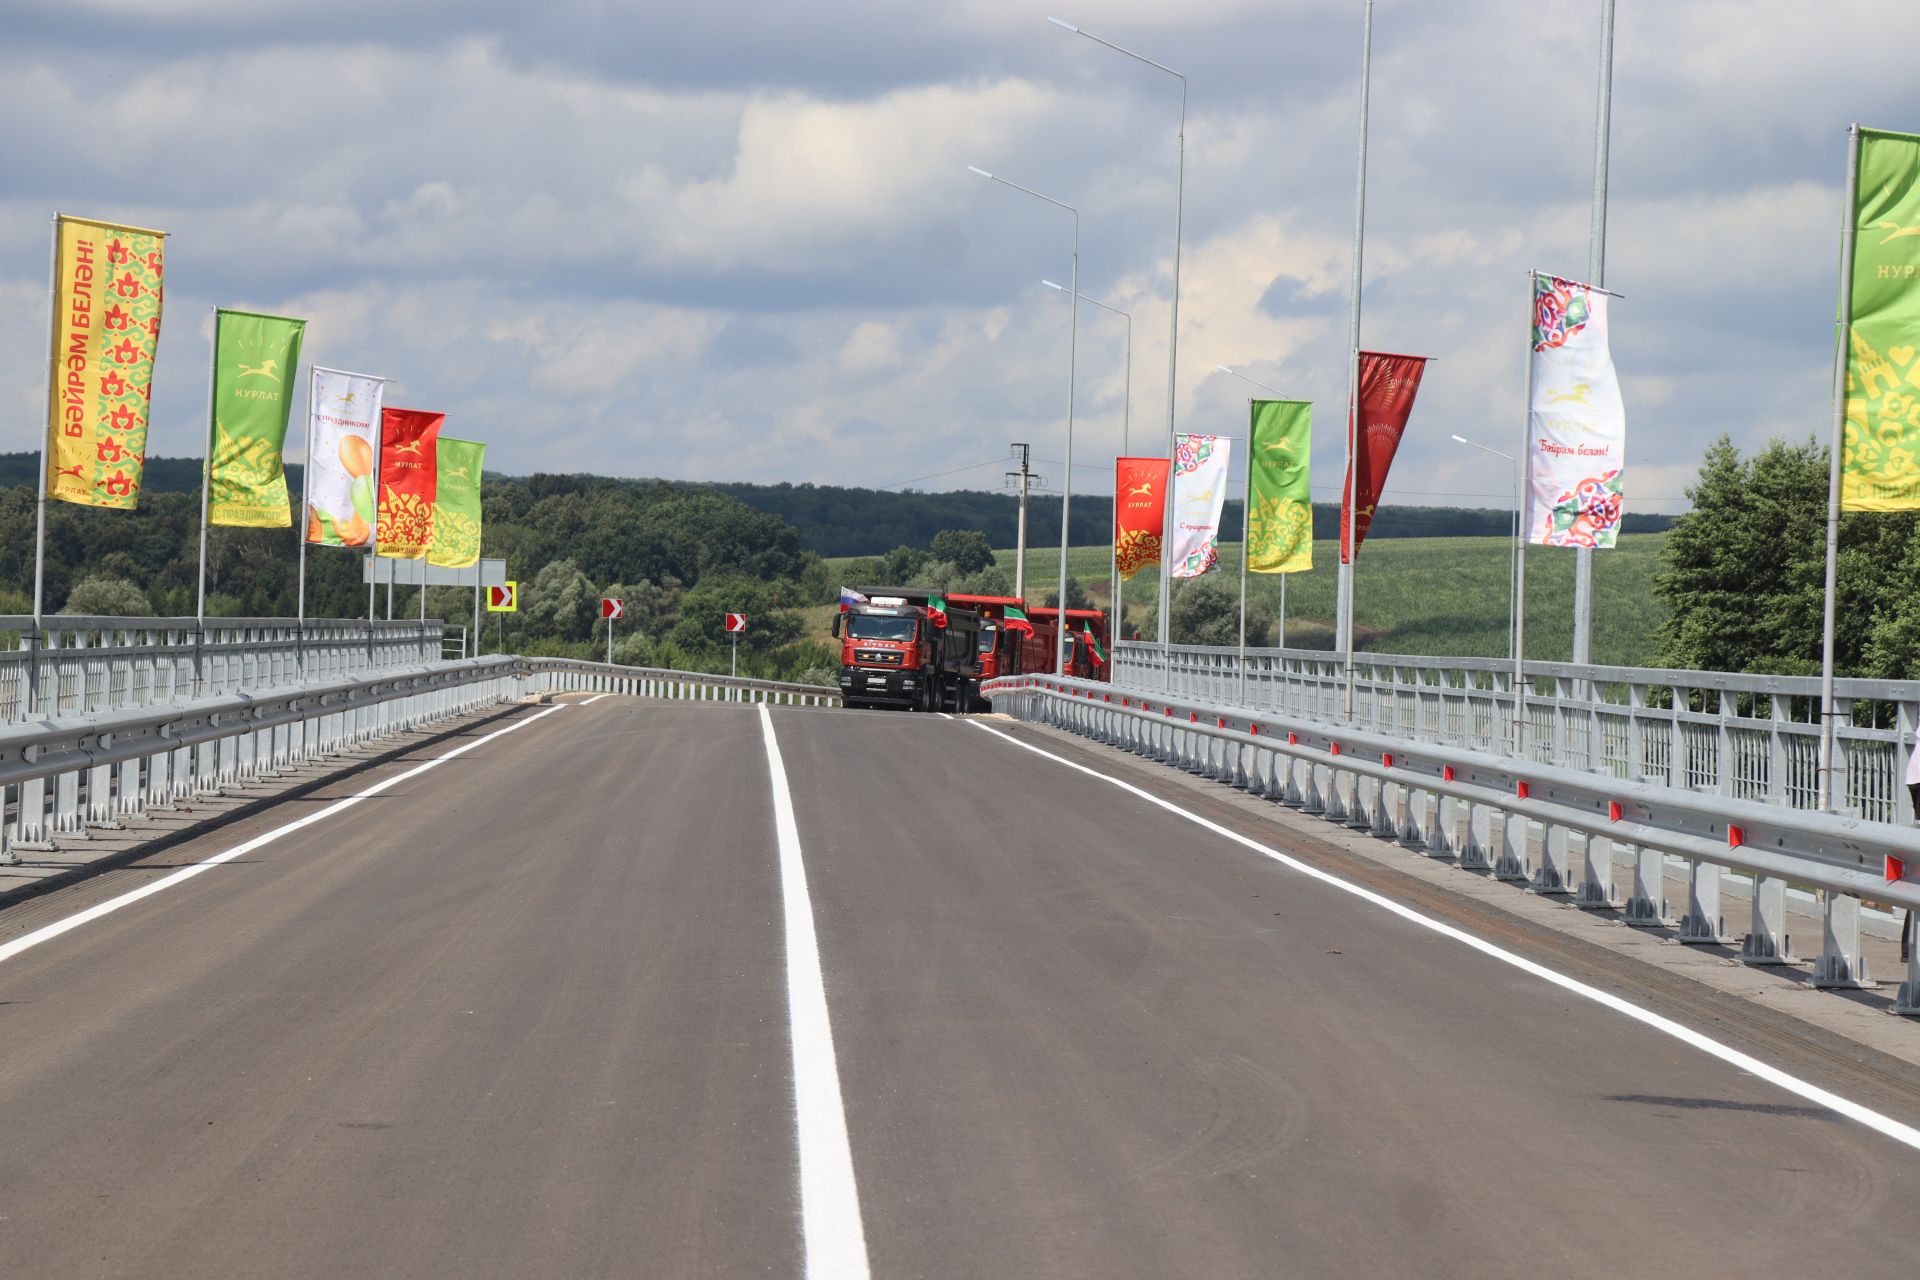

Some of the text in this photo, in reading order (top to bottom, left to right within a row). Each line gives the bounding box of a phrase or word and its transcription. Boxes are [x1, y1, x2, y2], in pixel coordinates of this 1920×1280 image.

[62, 239, 94, 438] БӘЙРӘМ БЕЛӘН!
[235, 388, 280, 401] НУРЛАТ
